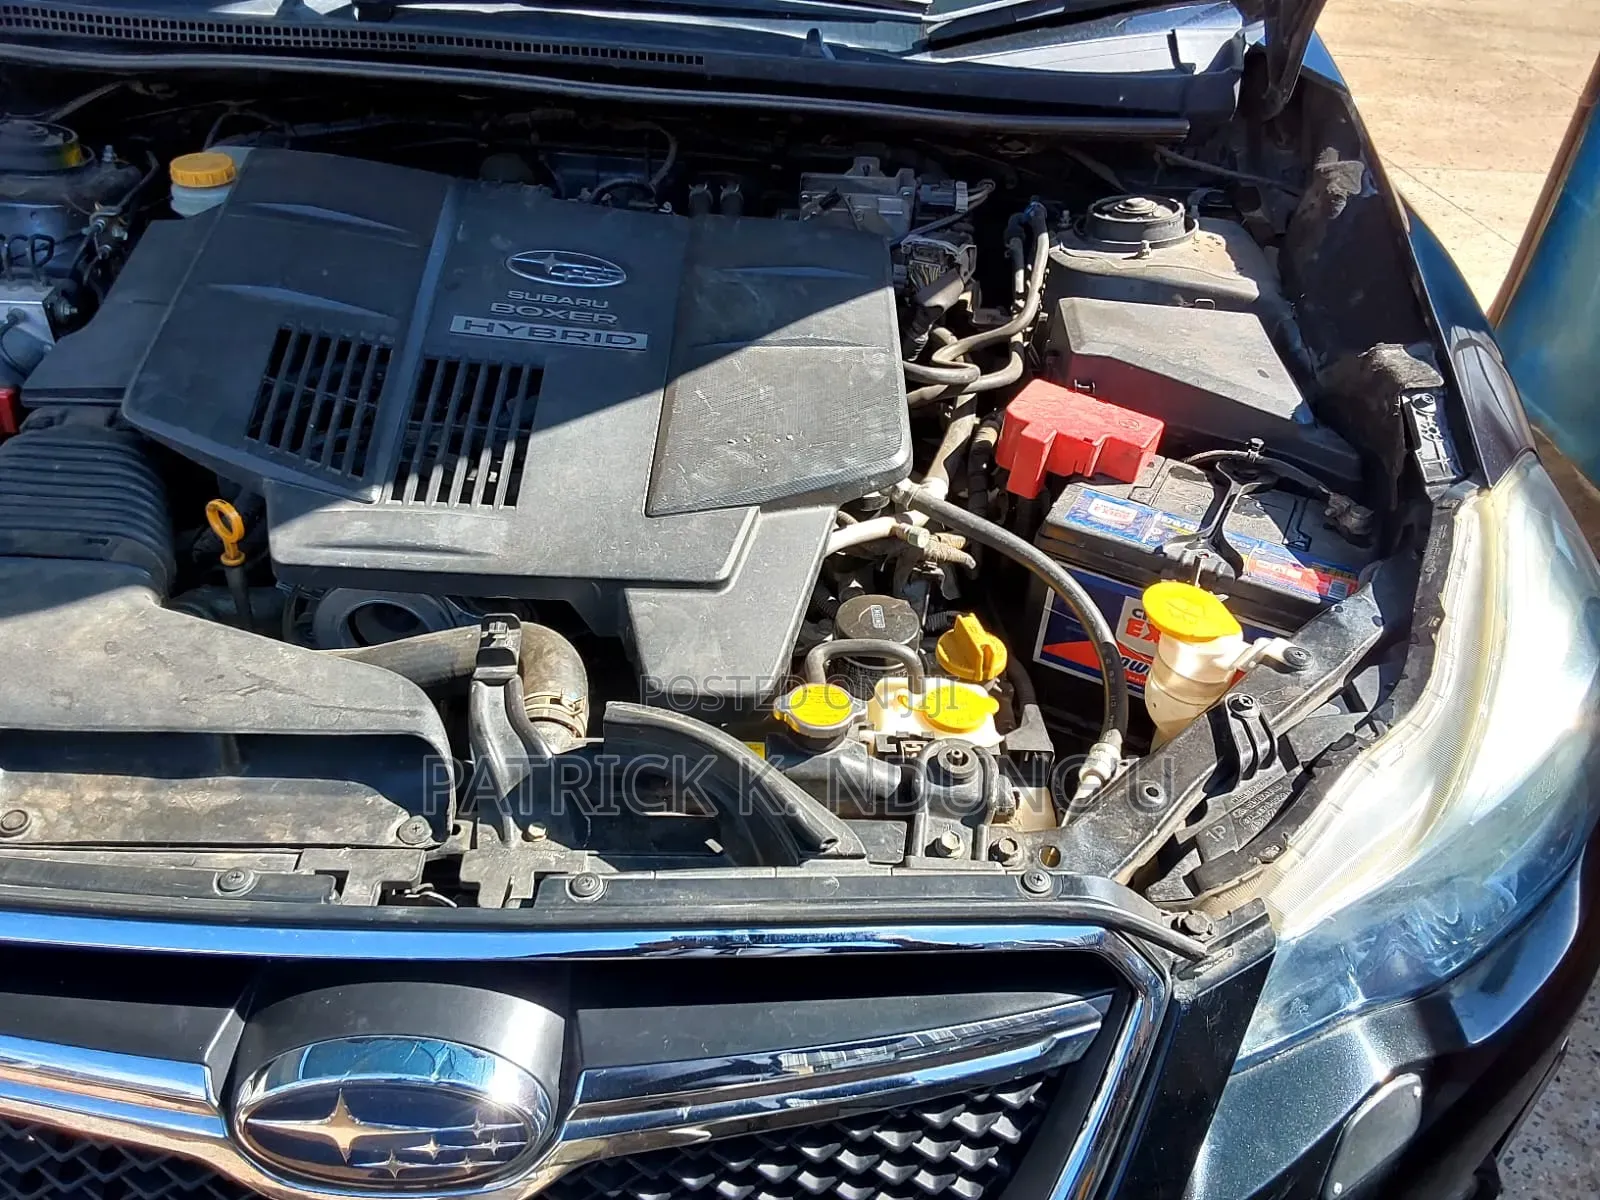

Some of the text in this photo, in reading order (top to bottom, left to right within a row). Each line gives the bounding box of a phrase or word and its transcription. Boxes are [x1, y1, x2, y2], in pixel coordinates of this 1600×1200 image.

[507, 290, 609, 309] SUBARU
[490, 302, 618, 326] BOXER
[463, 319, 637, 346] HYBRID
